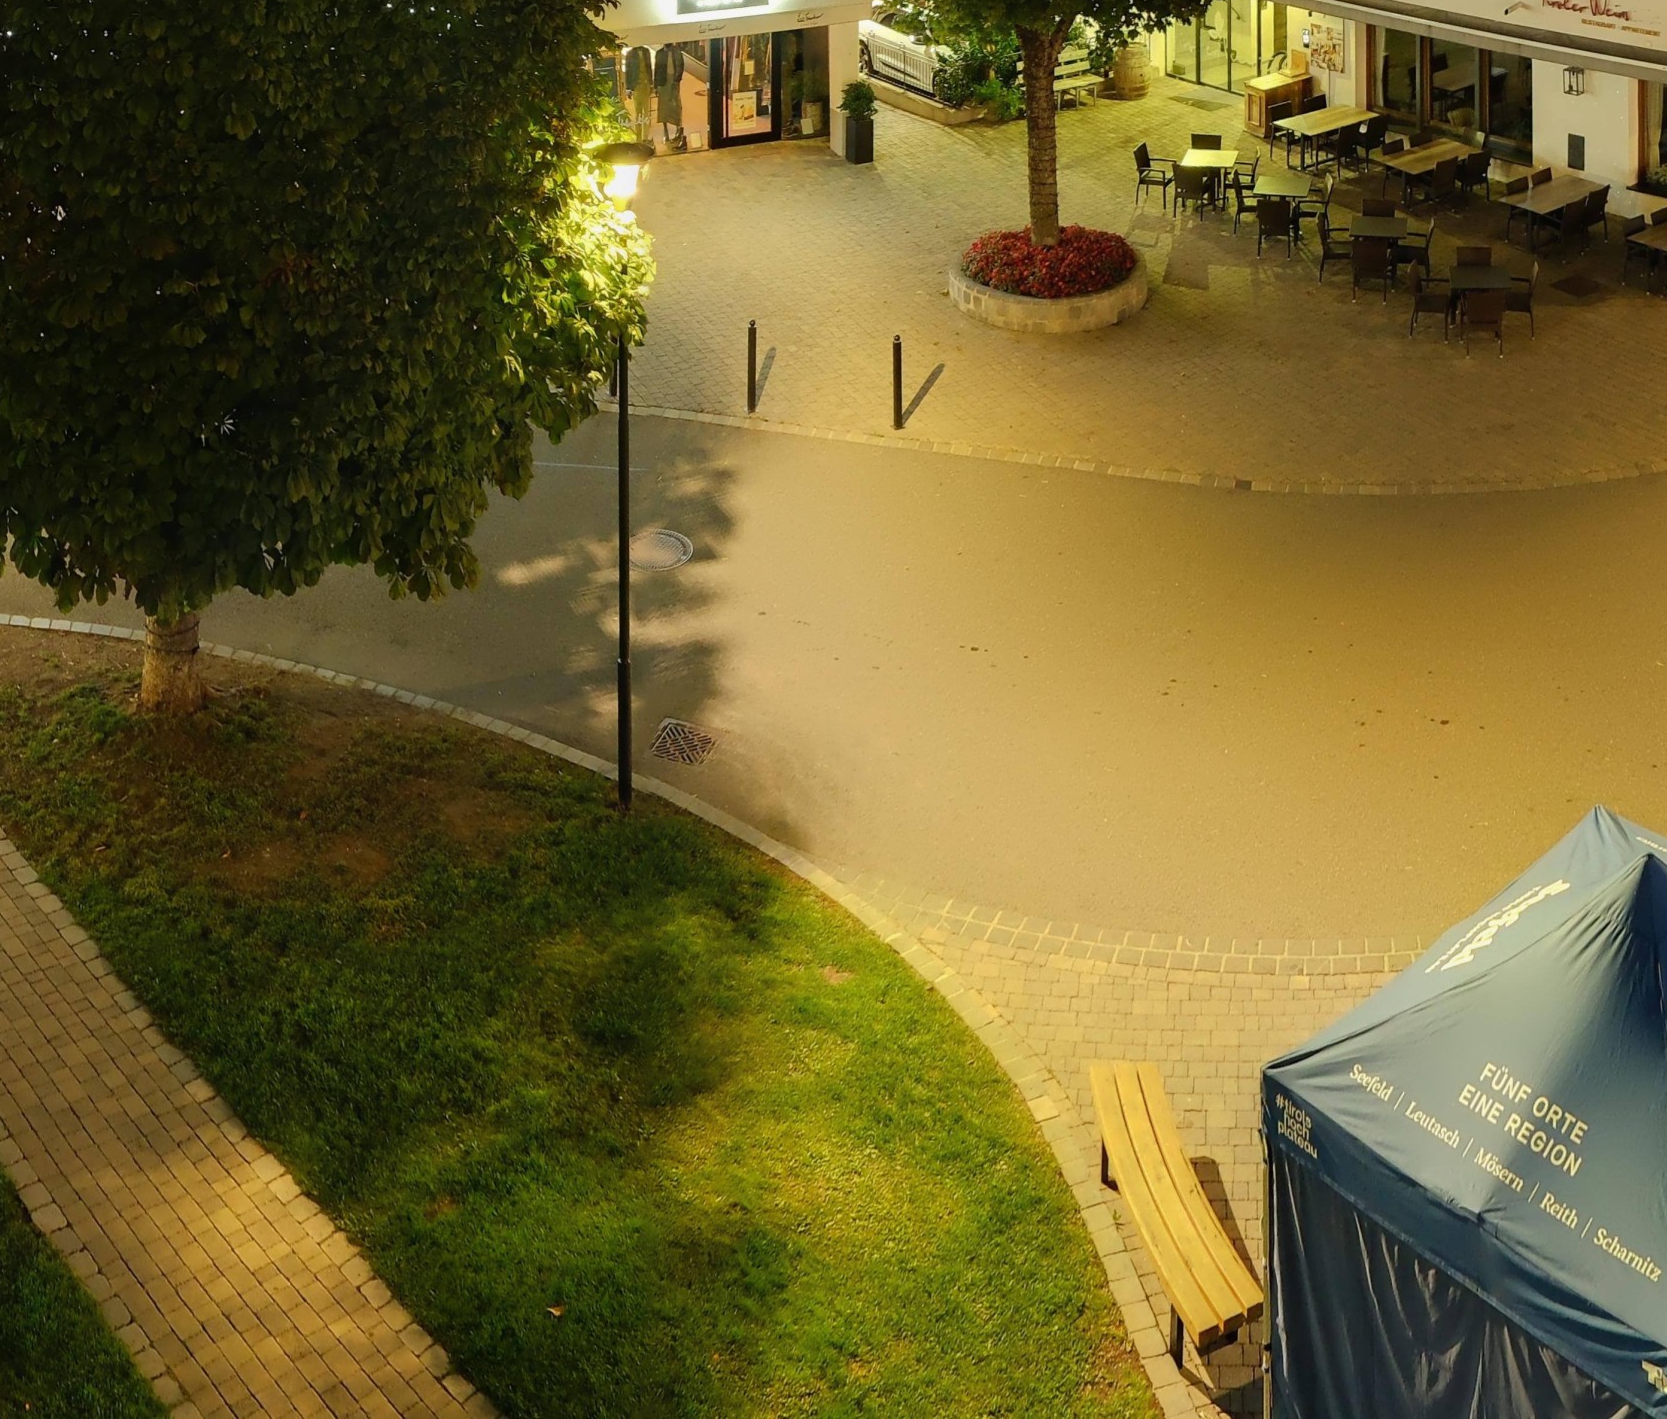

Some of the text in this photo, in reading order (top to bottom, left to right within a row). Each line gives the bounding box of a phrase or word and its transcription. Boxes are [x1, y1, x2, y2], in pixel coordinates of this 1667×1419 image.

[1458, 1084, 1582, 1177] EINE REGION
[1480, 1061, 1589, 1145] FÜNF ORTE
[1349, 1063, 1662, 1283] Seefeld Leutasch Mösern Reith Scharnitz
